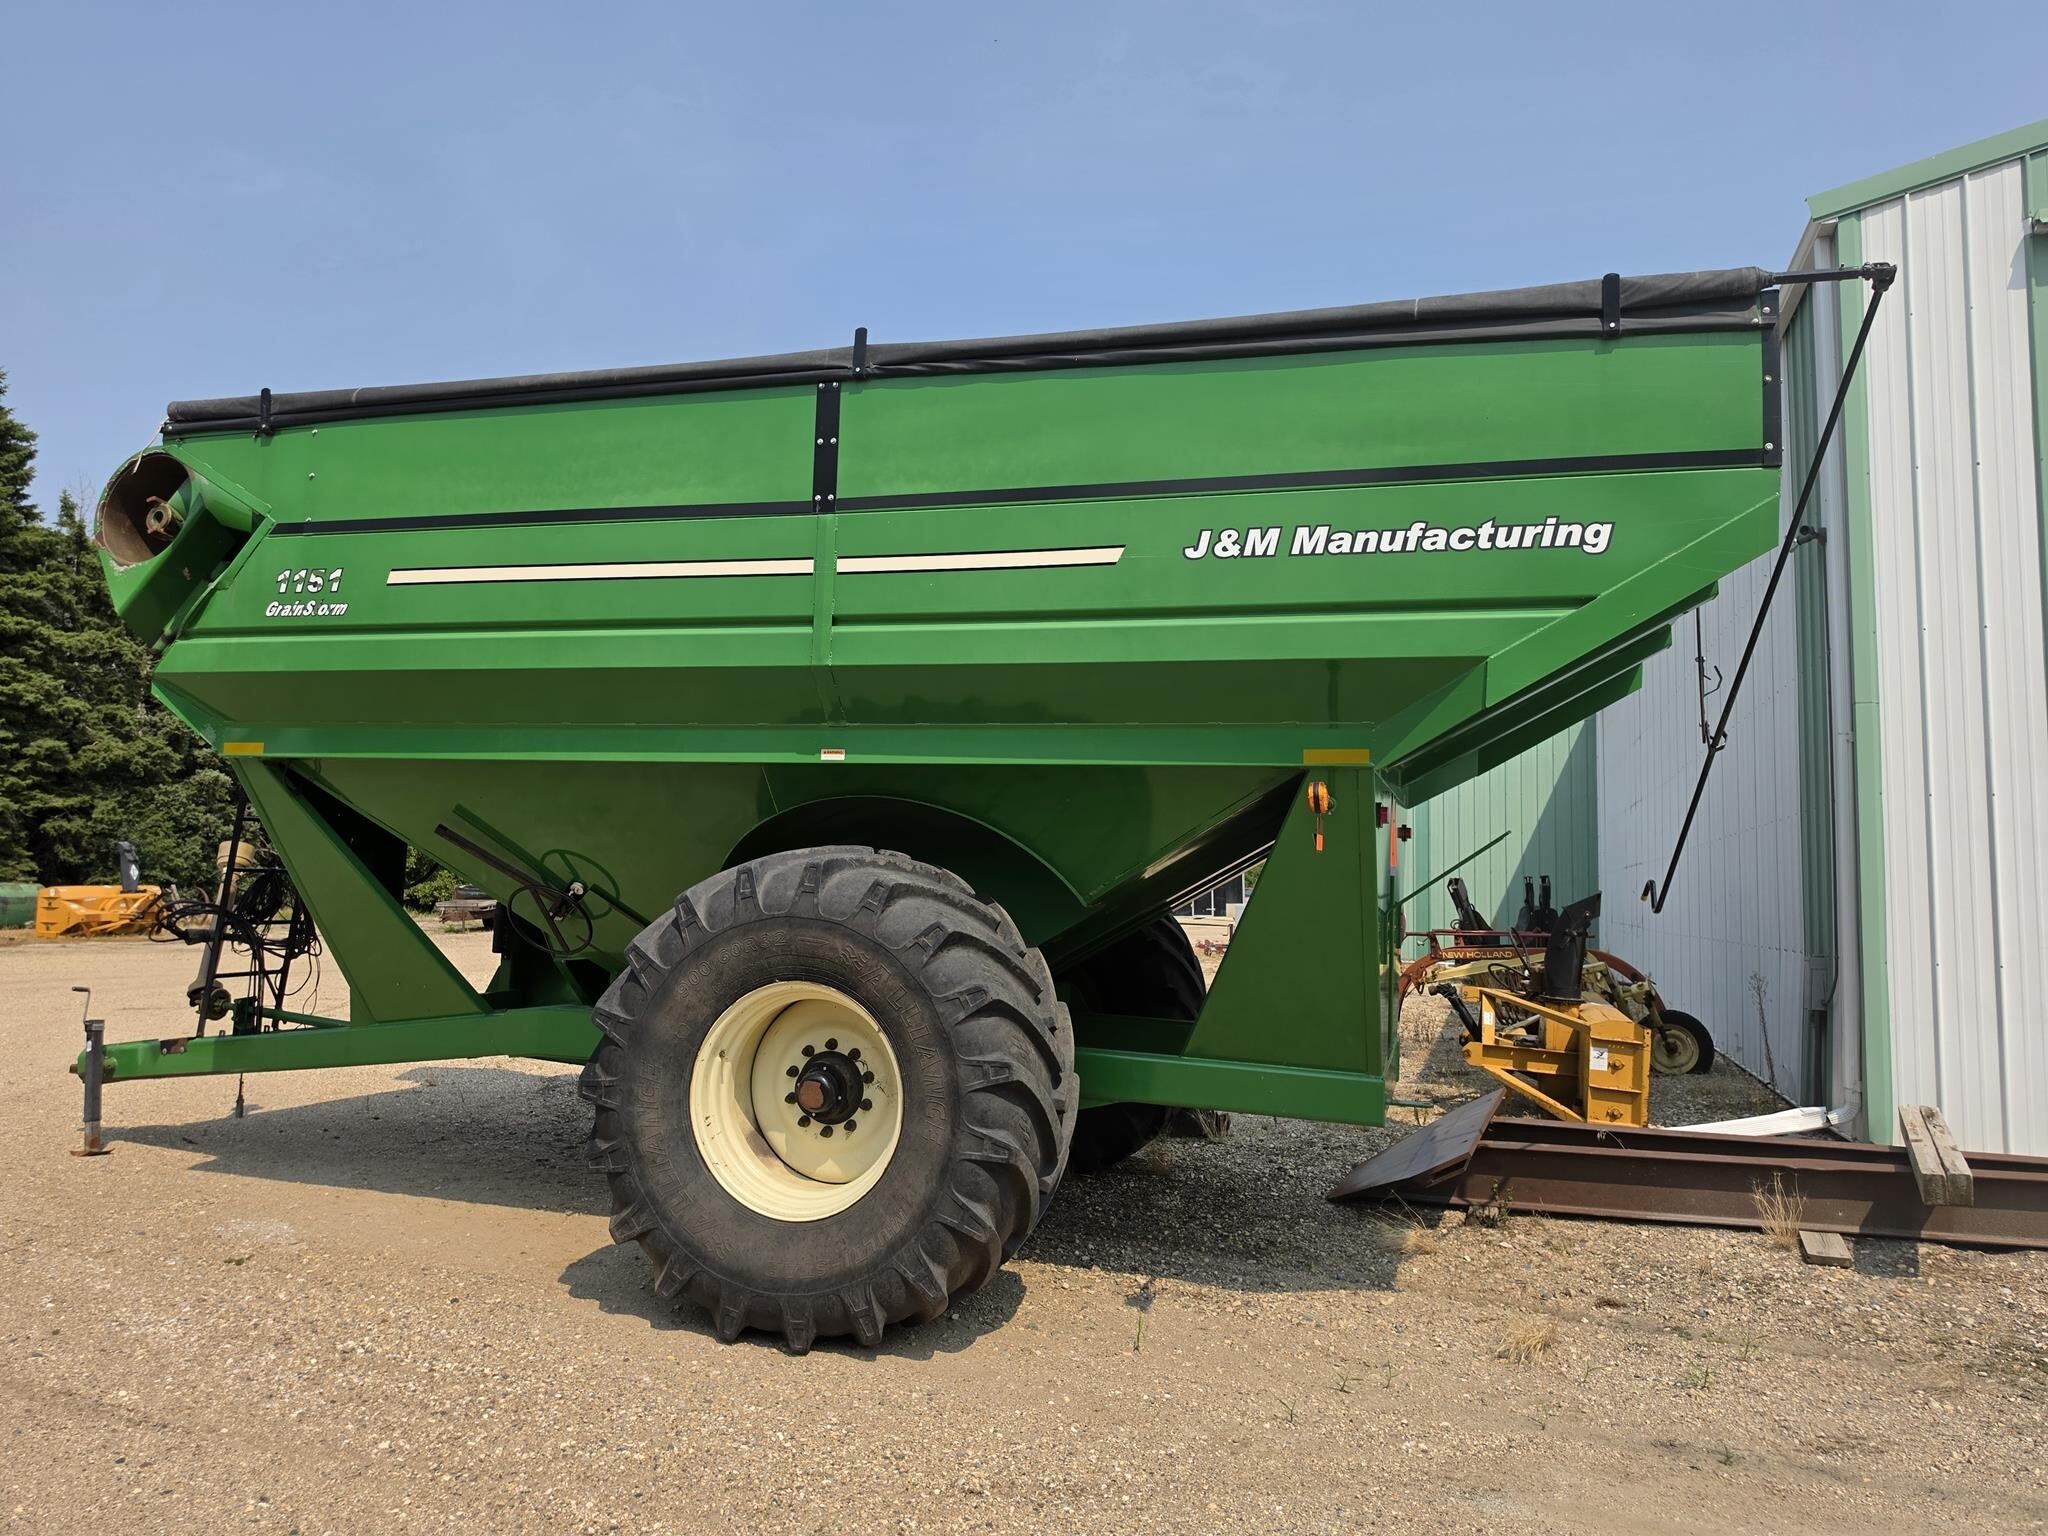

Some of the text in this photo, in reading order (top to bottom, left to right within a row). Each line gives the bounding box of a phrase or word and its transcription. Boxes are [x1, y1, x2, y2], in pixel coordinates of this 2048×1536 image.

[1183, 515, 1616, 560] J&M Manufacturing
[276, 568, 344, 594] 1151
[1442, 951, 1513, 959] NEW HOLLAND
